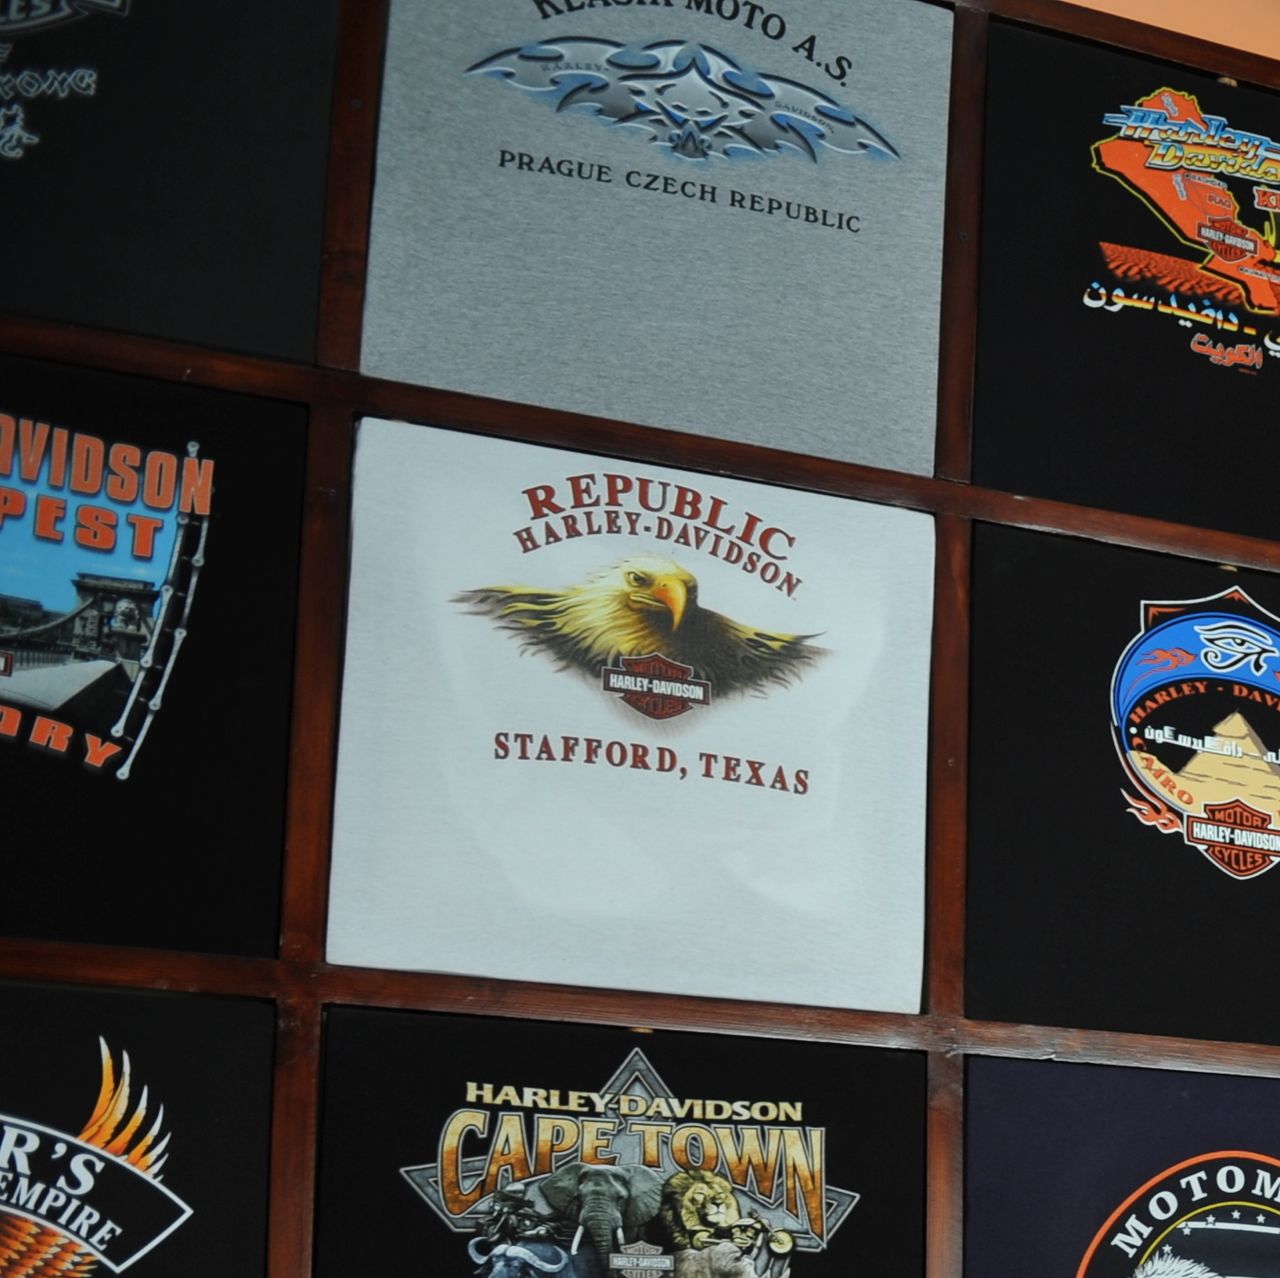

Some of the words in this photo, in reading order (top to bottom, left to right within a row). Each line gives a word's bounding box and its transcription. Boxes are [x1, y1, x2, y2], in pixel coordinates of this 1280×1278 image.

[499, 149, 613, 184] PRAGUE
[625, 170, 718, 204] CZECH
[729, 189, 862, 234] REPUBLIC
[521, 473, 797, 562] REPUBLIC
[512, 510, 803, 599] HARLEY-DAVIDSON
[609, 673, 704, 701] HARLEY-DAVIDSON
[1129, 680, 1208, 724] HARLEY
[493, 732, 689, 781] STAFFORD,
[699, 752, 810, 796] TEXAS
[1132, 736, 1194, 806] CAIRO
[1214, 804, 1263, 828] MOTOR
[1212, 847, 1265, 871] CYCLES
[465, 1081, 803, 1122] HARLEY-DAVIDSON
[438, 1108, 621, 1217] CAPE
[627, 1122, 827, 1252] TOWN
